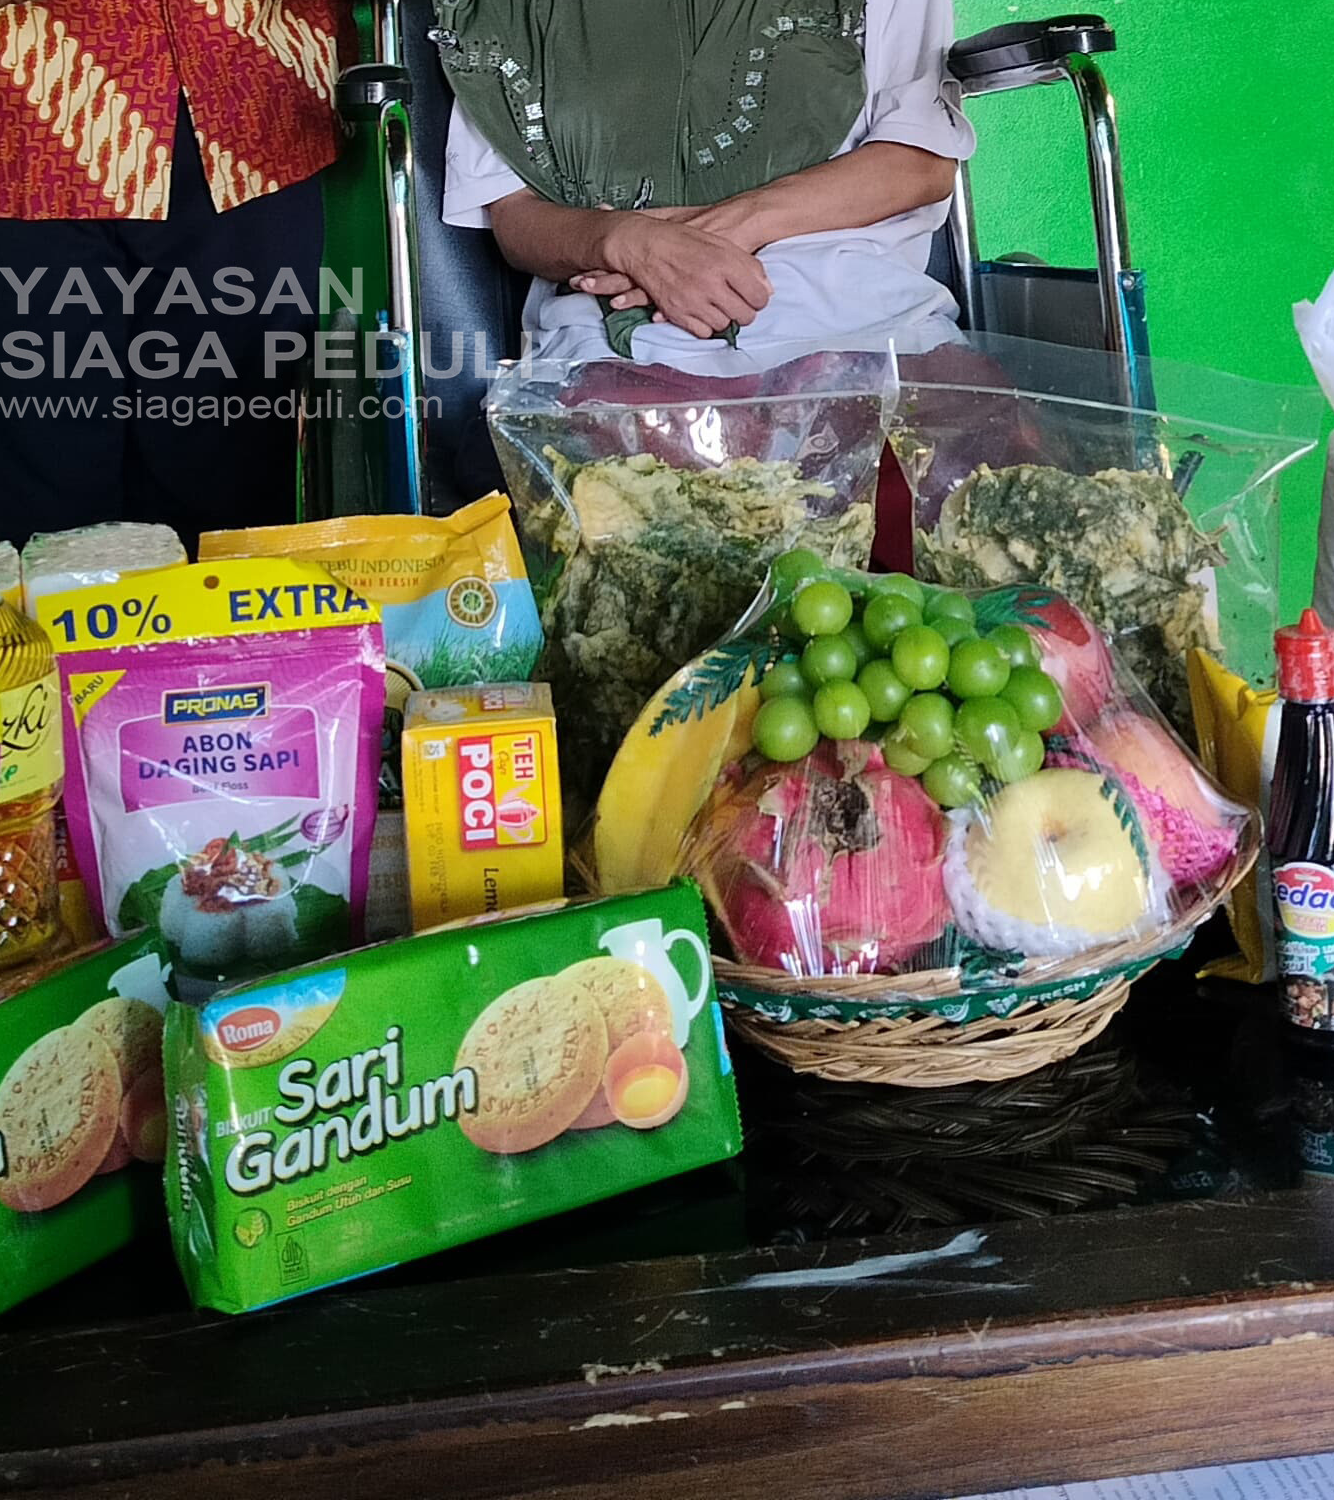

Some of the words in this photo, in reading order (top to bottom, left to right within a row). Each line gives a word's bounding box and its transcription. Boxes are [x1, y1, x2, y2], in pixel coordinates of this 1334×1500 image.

[360, 554, 447, 574] INDONESIA
[52, 594, 173, 644] 10%
[228, 583, 370, 624] EXTRA
[74, 674, 105, 706] BARU
[172, 691, 259, 716] PRONAS
[183, 731, 253, 754] ABON
[513, 736, 535, 780] TEH
[138, 754, 237, 780] DAGING
[244, 749, 300, 773] SAPI
[460, 743, 496, 841] POCI
[222, 1017, 276, 1045] Roma
[274, 1025, 400, 1124] Sari
[216, 1106, 272, 1138] BISKUIT
[224, 1068, 476, 1193] Gandum
[285, 1188, 324, 1213] Biskuit
[326, 1175, 367, 1198] dengan
[285, 1202, 333, 1228] Gandum
[334, 1191, 363, 1211] Utuh
[365, 1184, 385, 1201] dan
[386, 1173, 412, 1191] Susu
